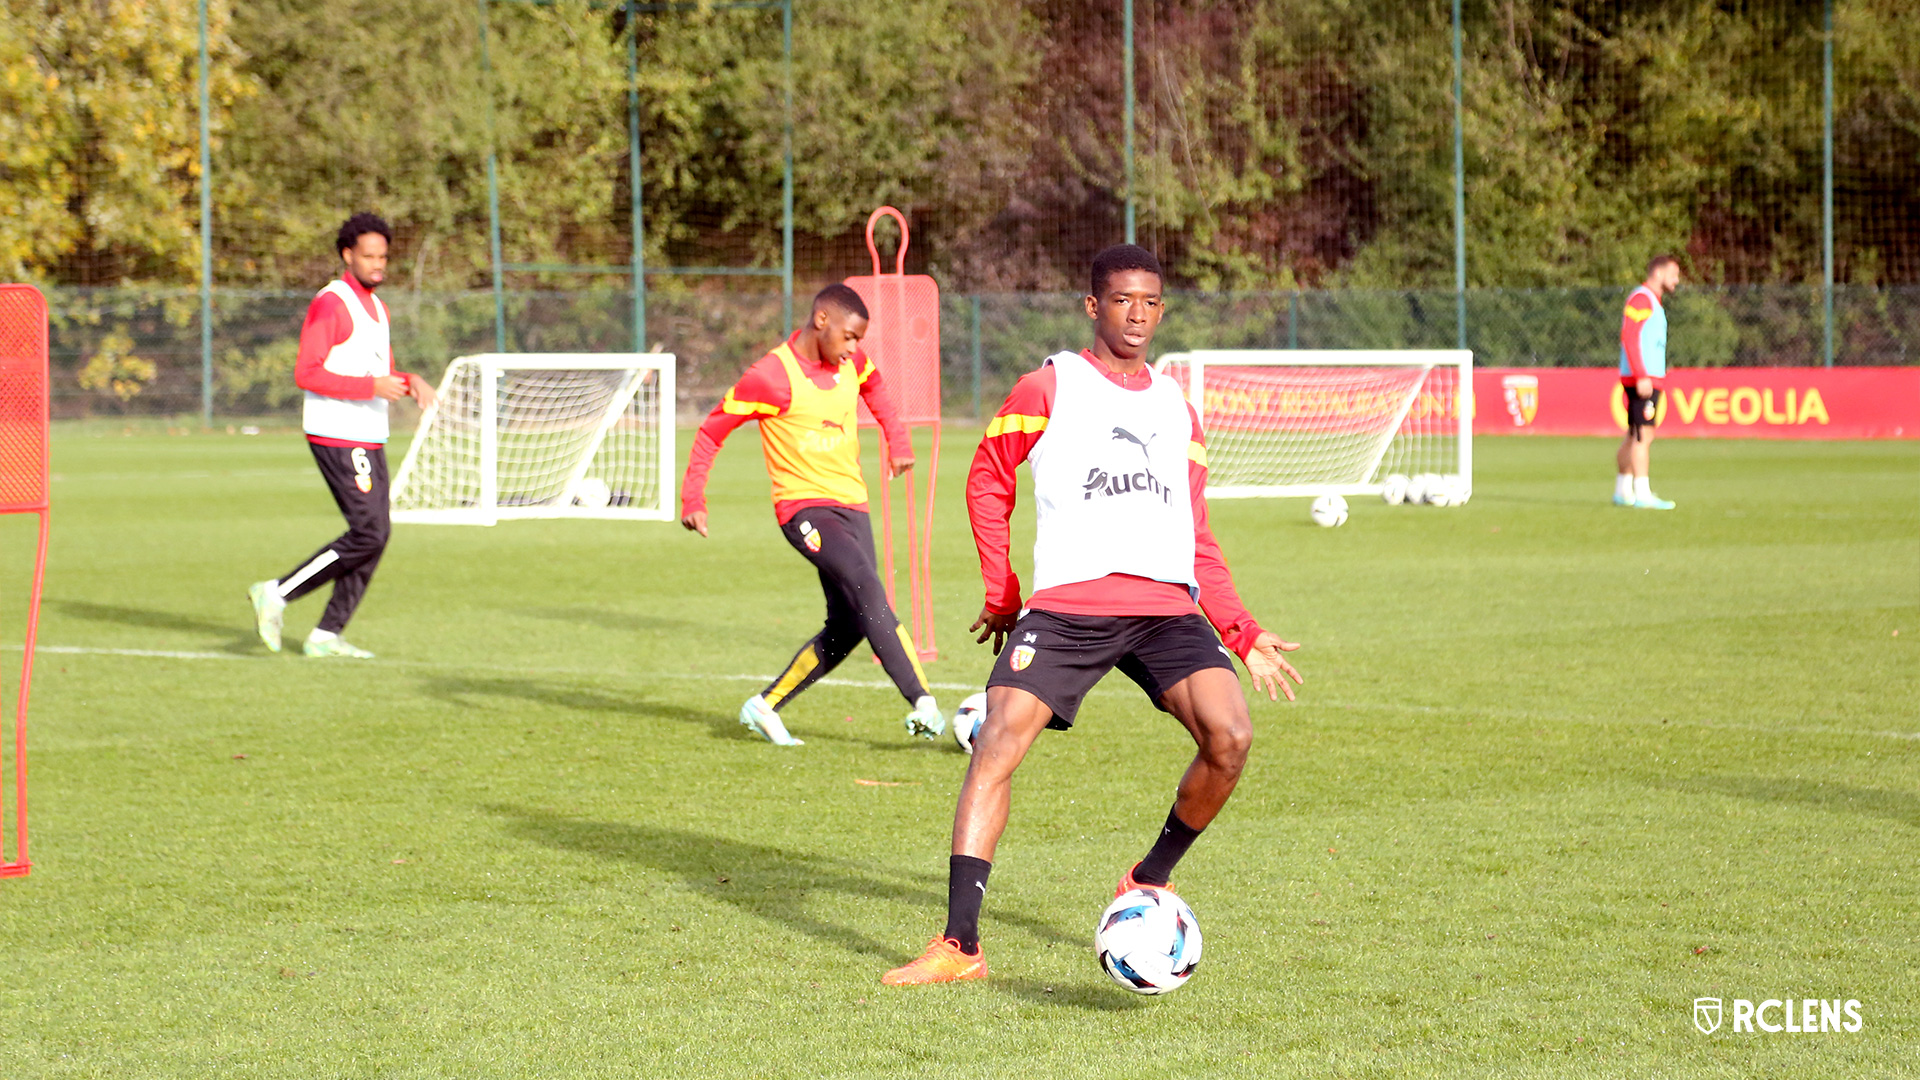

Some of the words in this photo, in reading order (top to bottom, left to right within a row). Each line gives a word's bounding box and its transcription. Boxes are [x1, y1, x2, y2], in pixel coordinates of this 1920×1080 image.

[1203, 388, 1276, 416] PONT
[1281, 390, 1444, 420] RESTAURATON
[1673, 387, 1830, 425] VEOLIA
[351, 446, 372, 475] 6
[1082, 467, 1172, 507] Auchn
